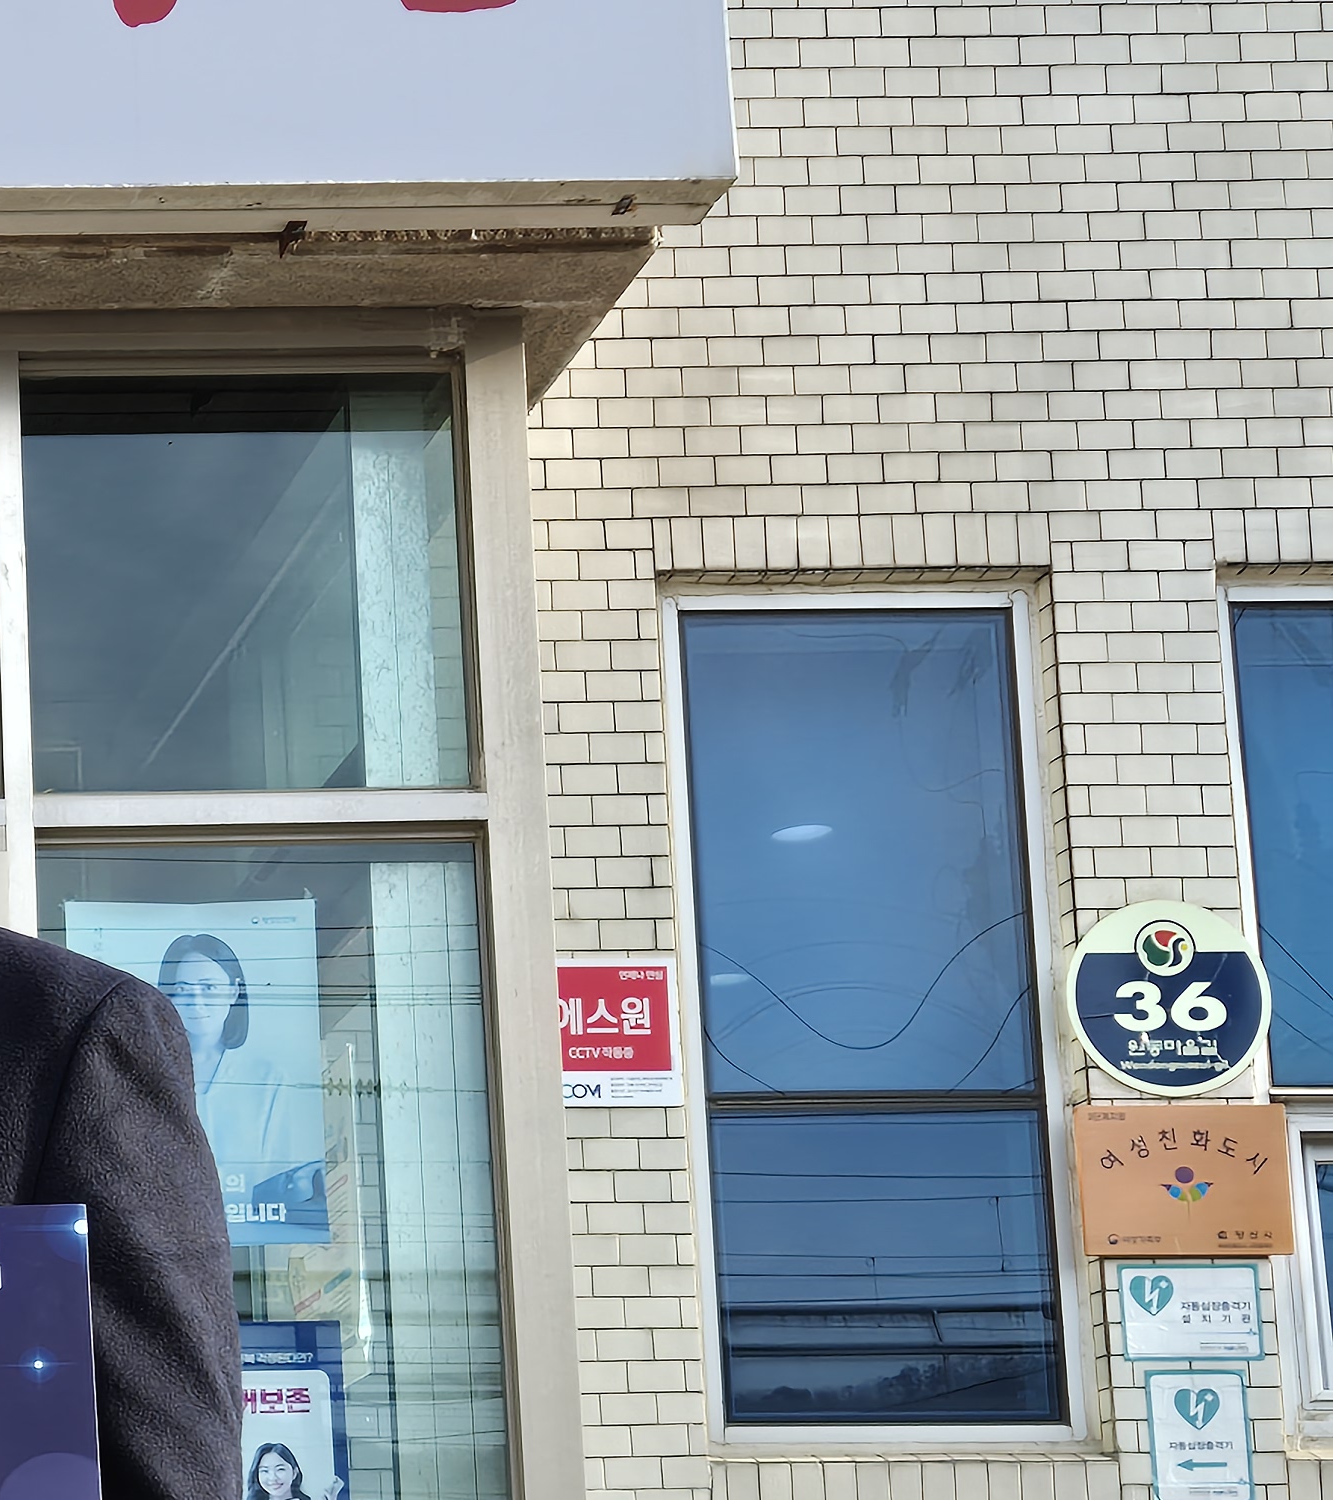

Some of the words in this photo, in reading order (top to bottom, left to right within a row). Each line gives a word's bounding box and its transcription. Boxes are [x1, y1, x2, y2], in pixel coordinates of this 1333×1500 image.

[558, 997, 651, 1035] 에스원
[1114, 981, 1227, 1032] 36
[568, 1046, 601, 1059] CCTV
[563, 1083, 601, 1099] COM
[1100, 1127, 1268, 1175] 여성친화도시
[224, 1202, 286, 1223] 입니다
